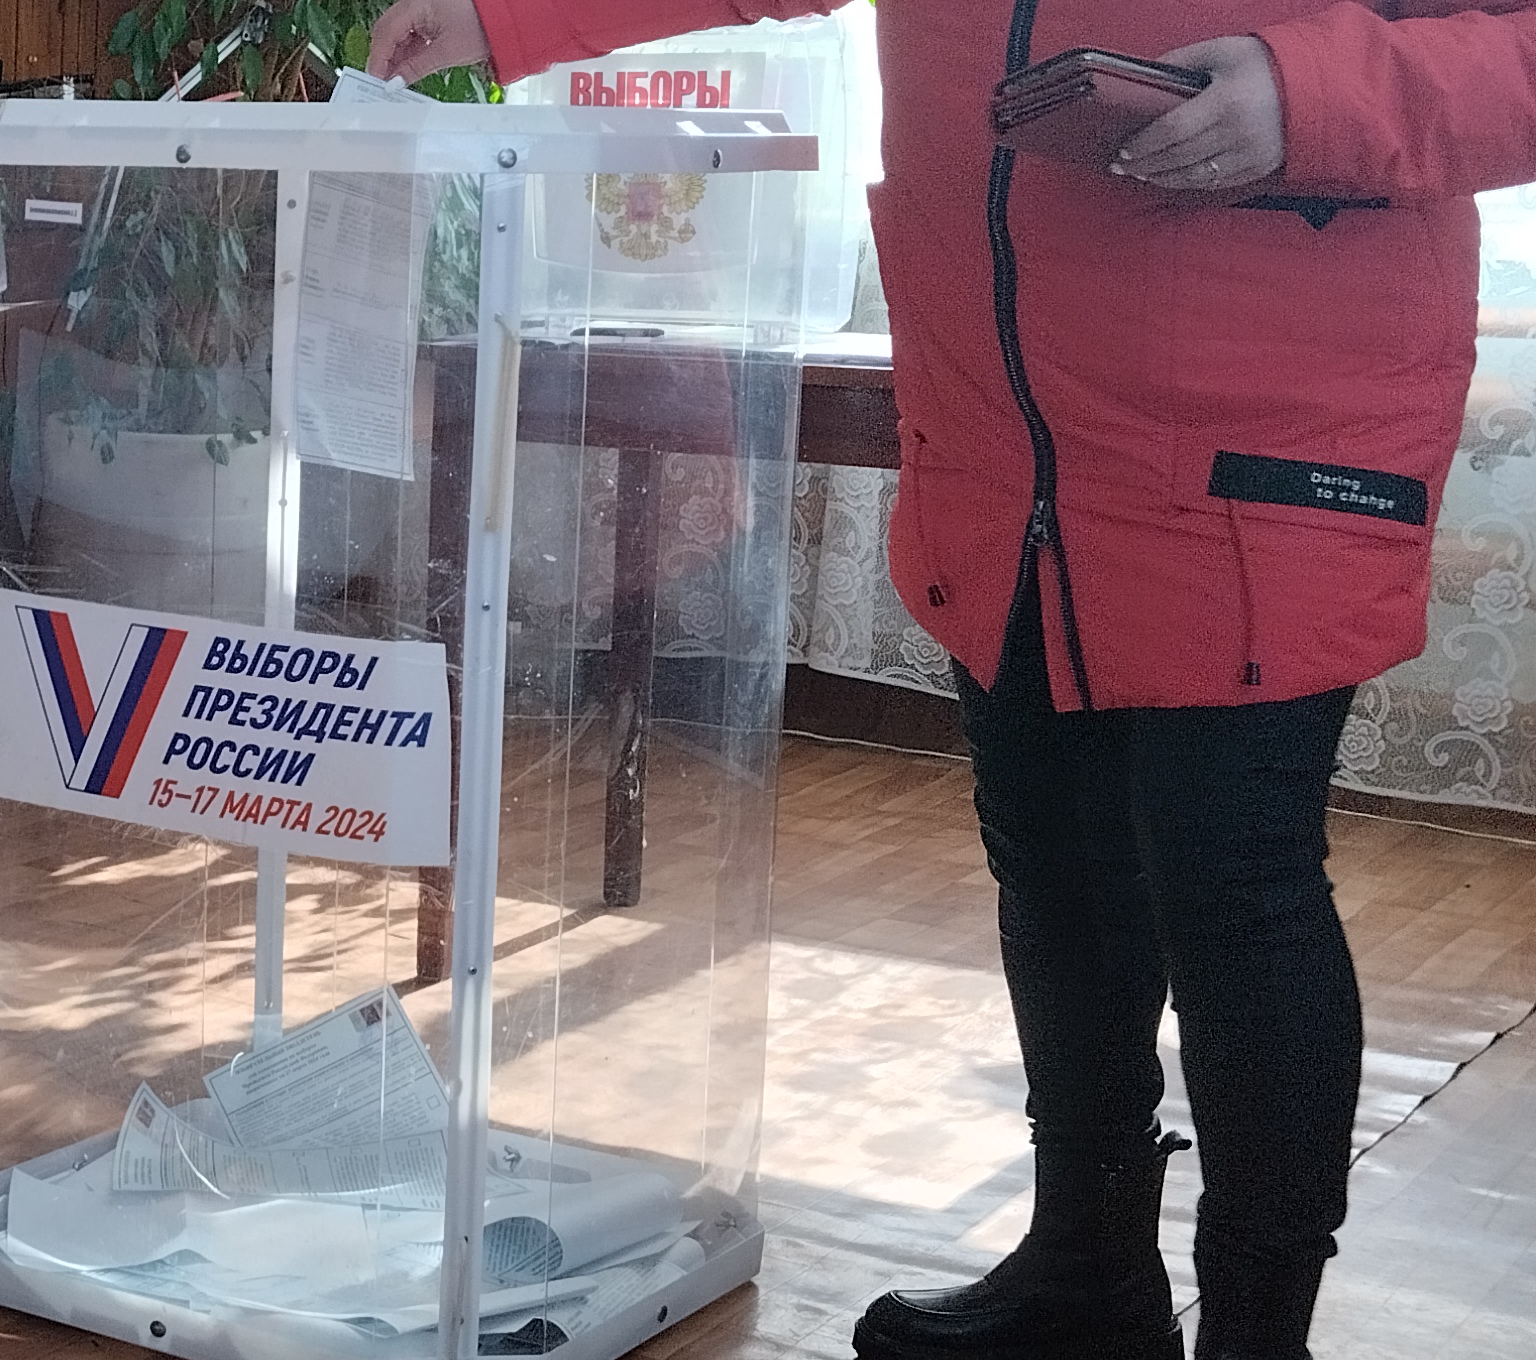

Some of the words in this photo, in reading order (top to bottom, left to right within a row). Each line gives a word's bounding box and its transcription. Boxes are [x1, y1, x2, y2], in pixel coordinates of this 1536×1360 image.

[570, 70, 731, 109] ВЫБОРЫ
[1310, 471, 1361, 491] Daring
[1316, 487, 1333, 499] to
[1339, 490, 1395, 510] change
[202, 636, 378, 691] ВЫБОРЫ
[182, 684, 433, 749] ПРЕЗИДЕНТА
[162, 732, 316, 787] РОССИИ
[219, 788, 315, 833] МАРТА
[315, 805, 388, 843] 2024
